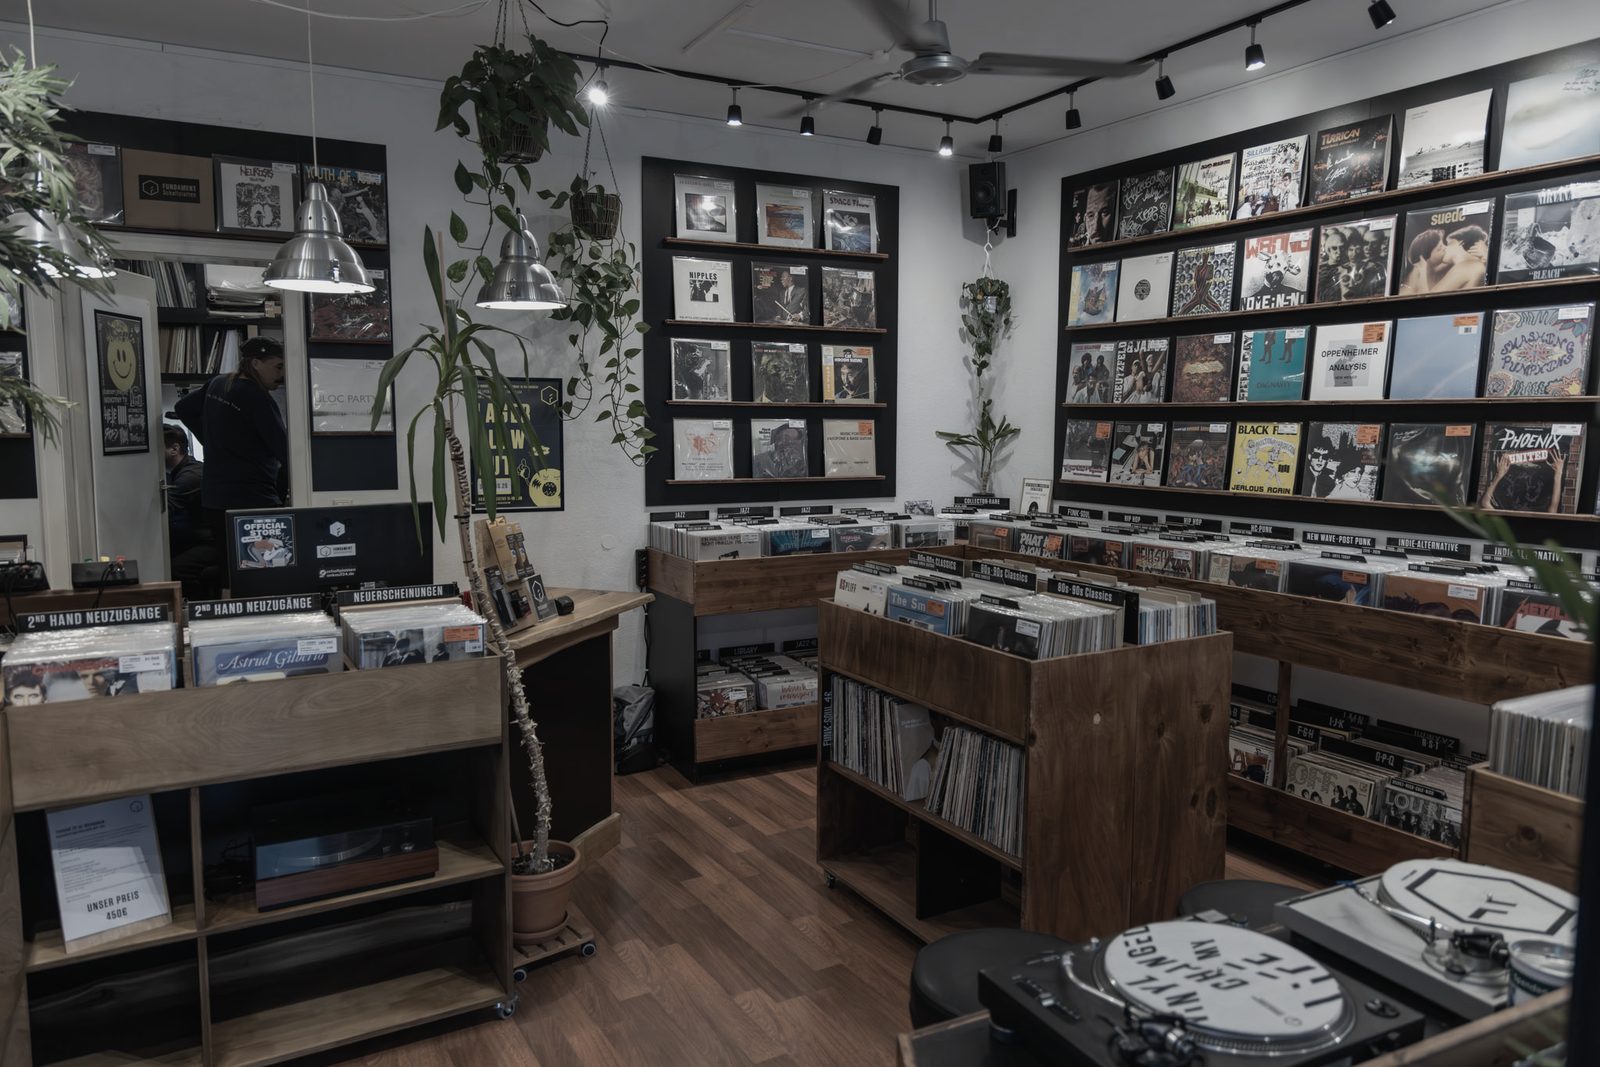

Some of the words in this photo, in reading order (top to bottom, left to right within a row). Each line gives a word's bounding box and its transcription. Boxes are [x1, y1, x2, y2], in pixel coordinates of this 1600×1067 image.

[1322, 128, 1360, 146] TURRICAN
[1430, 208, 1466, 226] suede
[689, 272, 718, 281] NIPPLES
[1500, 331, 1575, 355] SMASHING
[1321, 347, 1379, 358] OPPENHEIMER
[1328, 363, 1367, 371] ANALYSIS
[1238, 425, 1269, 435] BLACK
[1498, 428, 1564, 450] PHOENIX
[1508, 450, 1548, 464] UNITED
[1231, 484, 1264, 493] JEALOUS
[1267, 486, 1291, 494] AGAIN
[675, 511, 686, 519] JAZZ
[243, 522, 287, 531] OFFICIAL
[250, 528, 282, 537] STORE
[1019, 532, 1044, 547] PHAT
[1306, 532, 1319, 541] NEW
[1355, 537, 1371, 546] PUNK
[1398, 538, 1459, 552] INDIE-ALTERNATIVE
[1004, 568, 1029, 584] Classics
[353, 585, 443, 603] NEUERSCHEINUNGEN
[891, 592, 907, 606] The
[1084, 587, 1113, 602] Classics
[194, 603, 211, 617] 2ND
[214, 602, 243, 615] HAND
[246, 597, 312, 613] NEUZUGÄNGE
[27, 614, 46, 629] 2ND
[50, 613, 82, 627] HAND
[86, 606, 161, 624] NEUZUGÄNGE
[733, 645, 758, 656] LIBRARY
[217, 652, 273, 671] Astrud
[1384, 788, 1424, 814] LOU
[87, 896, 115, 912] UNSER
[116, 890, 140, 905] PREIS
[106, 907, 128, 921] 450€
[1191, 938, 1221, 961] MY
